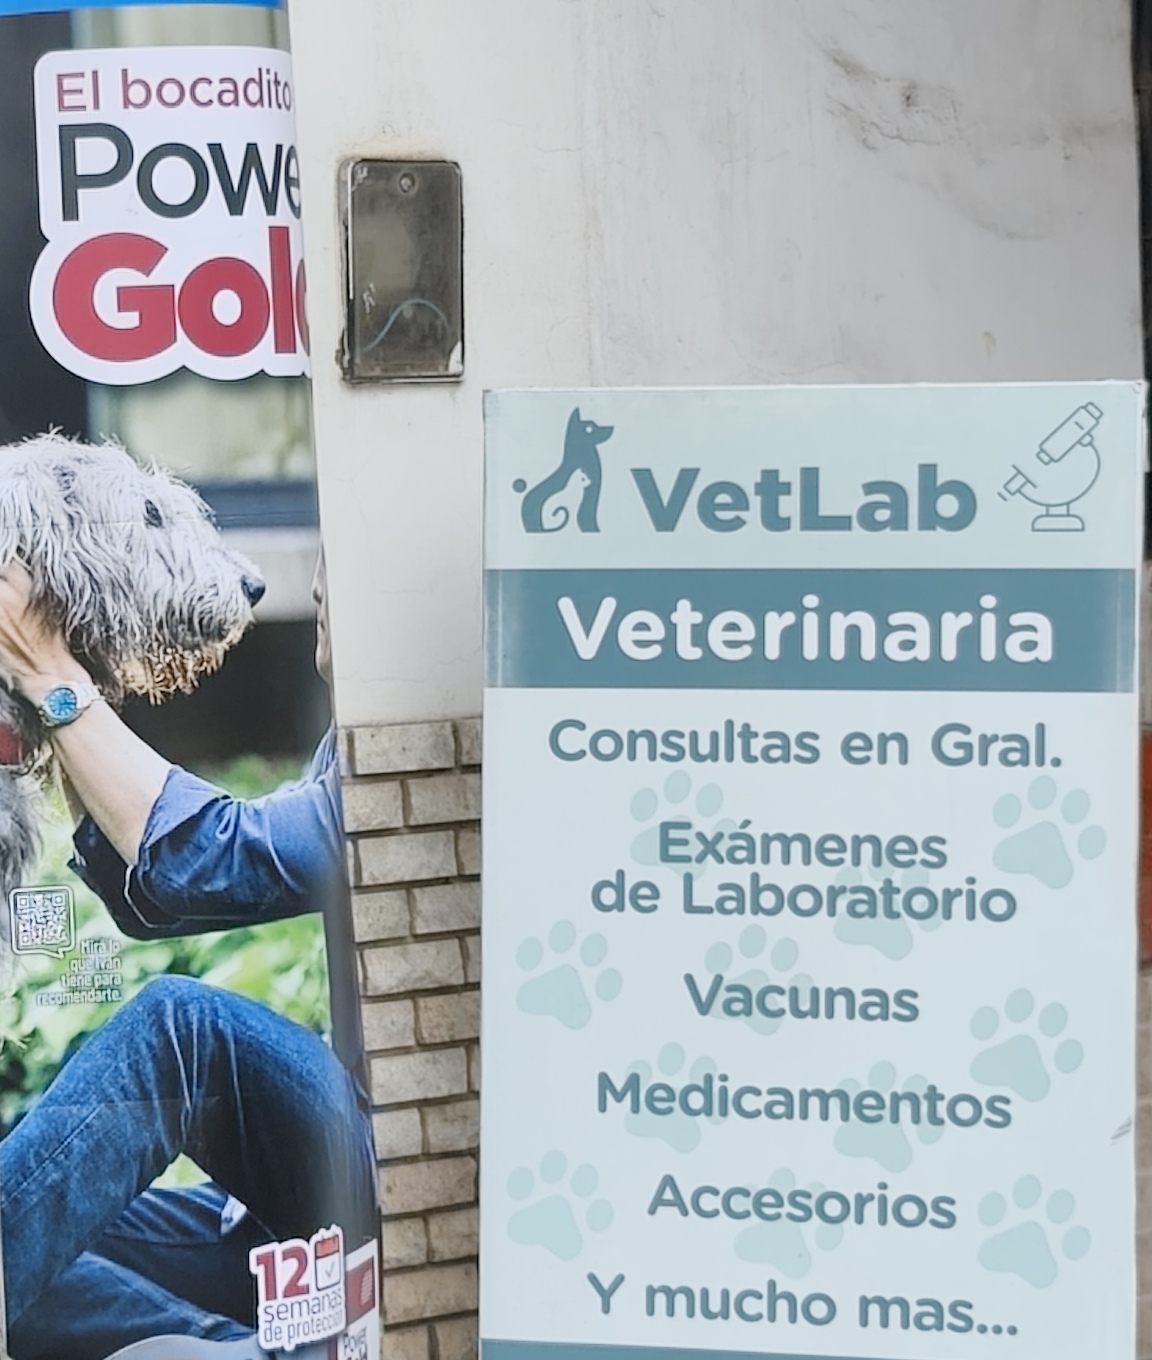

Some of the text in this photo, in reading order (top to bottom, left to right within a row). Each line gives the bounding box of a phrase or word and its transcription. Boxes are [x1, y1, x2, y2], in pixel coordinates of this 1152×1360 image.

[56, 67, 292, 113] El bocadito
[629, 463, 978, 533] VetLab
[556, 594, 1054, 664] Veterinaria
[548, 718, 1062, 769] Consultas en Gral.
[658, 820, 949, 870] Exámenes
[591, 869, 1017, 923] de Laboratorio
[683, 973, 920, 1023] Vacunas
[597, 1072, 1013, 1129] Medicamentos
[647, 1174, 958, 1229] Accesorios
[256, 1245, 310, 1301] 12
[264, 1287, 343, 1323] semanas
[587, 1272, 1018, 1336] Y mucho mas...
[264, 1321, 282, 1343] de
